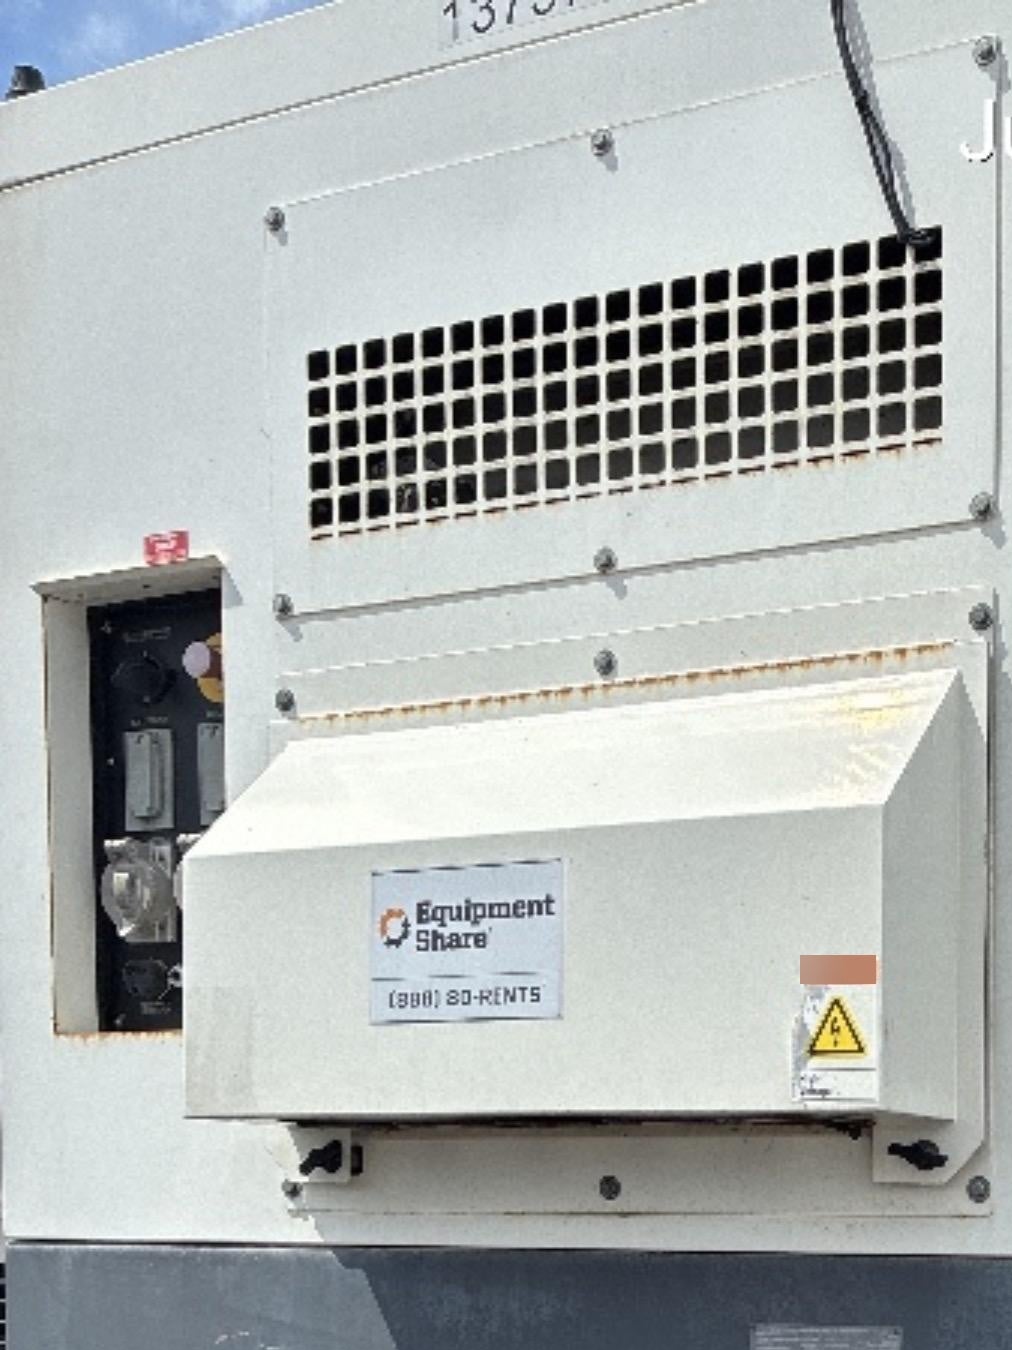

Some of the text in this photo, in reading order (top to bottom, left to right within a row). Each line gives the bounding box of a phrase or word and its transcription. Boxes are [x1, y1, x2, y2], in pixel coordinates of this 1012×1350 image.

[416, 894, 556, 927] Equipment
[416, 929, 488, 952] Share
[446, 986, 541, 1006] 80-RENTS
